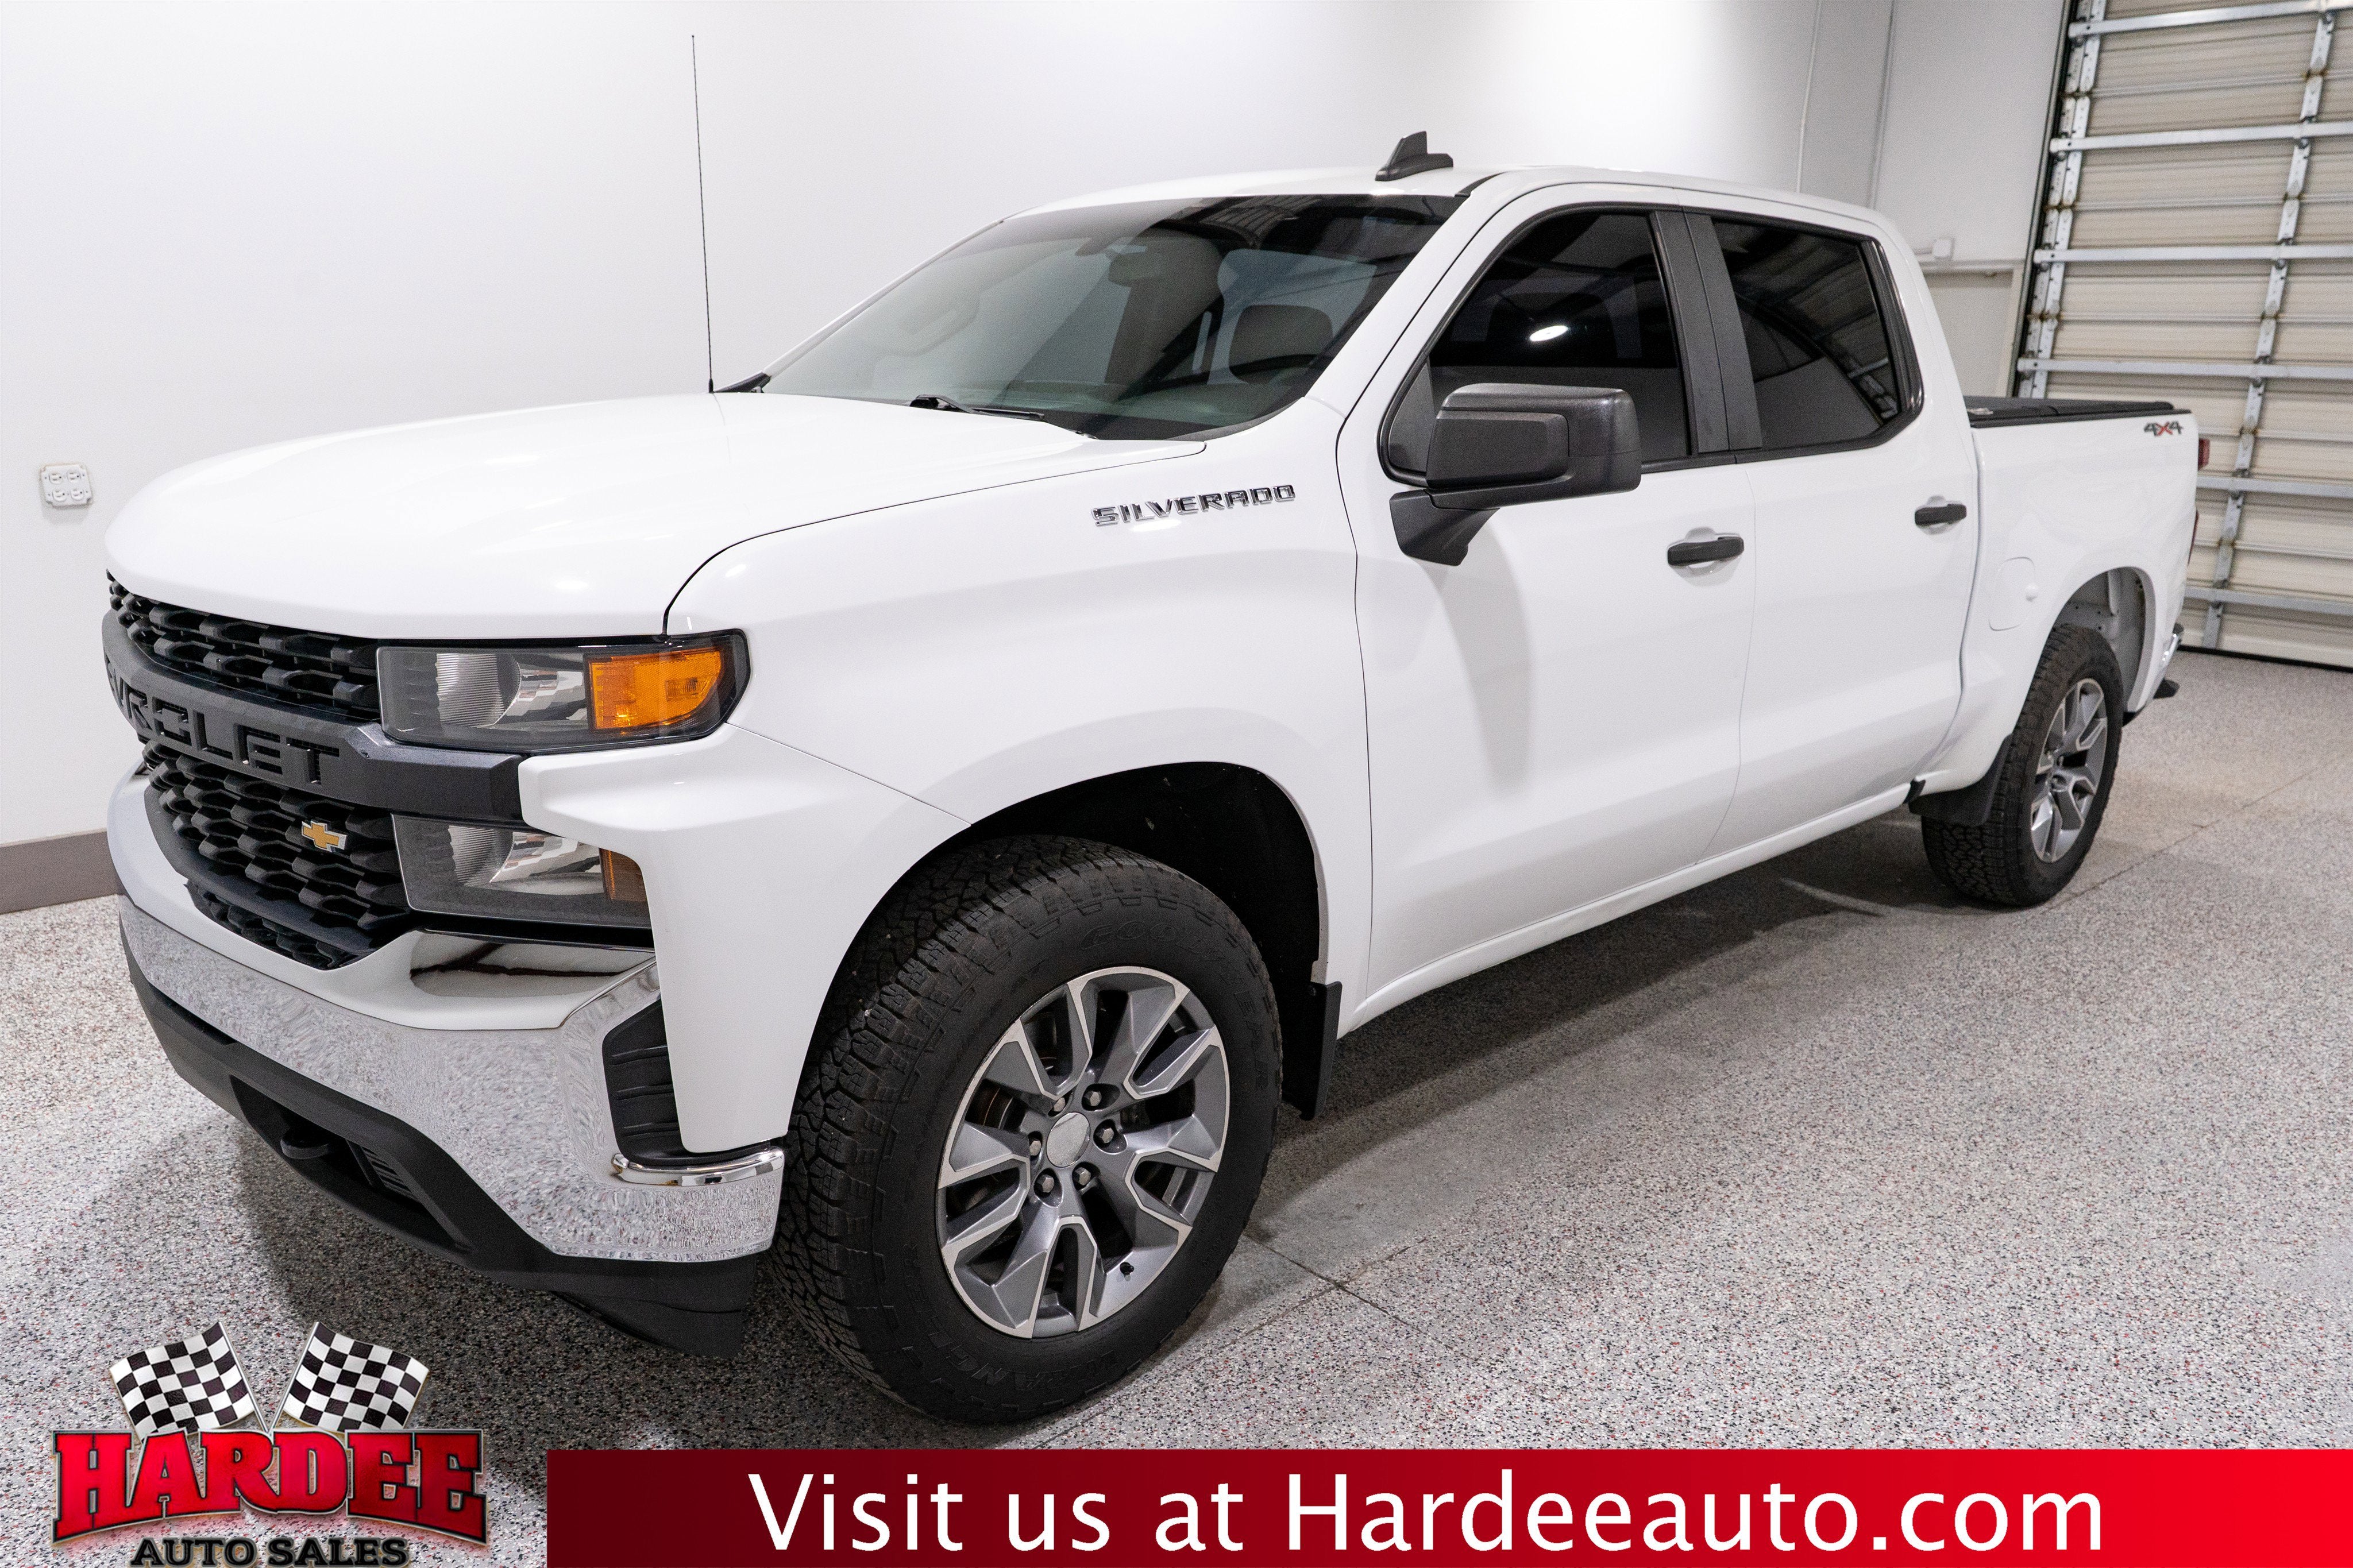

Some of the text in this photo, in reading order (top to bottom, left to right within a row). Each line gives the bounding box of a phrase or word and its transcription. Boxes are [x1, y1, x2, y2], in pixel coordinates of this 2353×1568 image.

[1091, 484, 1297, 527] SILVERADO
[103, 651, 340, 785] VROLET
[1079, 920, 1268, 1092] GOODYEAR
